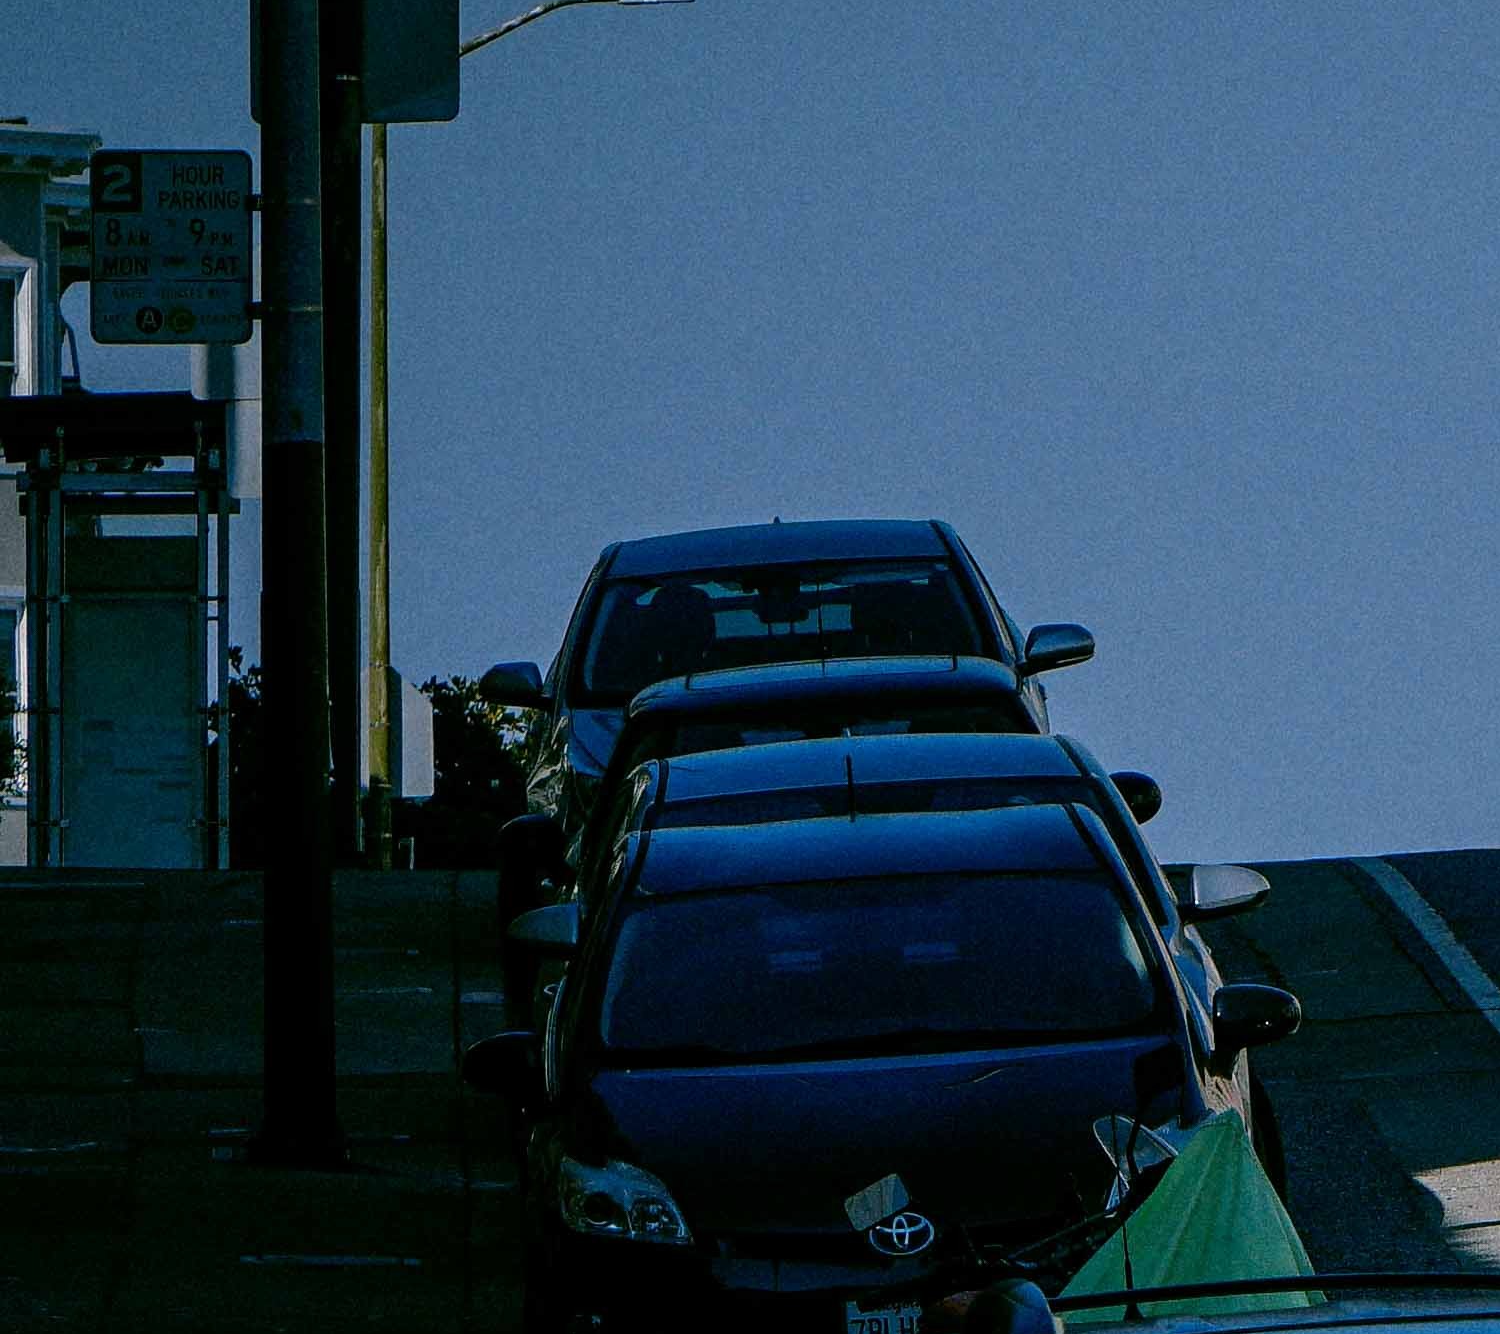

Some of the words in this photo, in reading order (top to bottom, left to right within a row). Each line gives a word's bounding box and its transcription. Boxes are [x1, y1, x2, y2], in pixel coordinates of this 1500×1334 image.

[102, 164, 133, 202] 2
[171, 163, 225, 186] HOUR
[158, 189, 241, 210] PARKING
[105, 218, 121, 247] 8
[190, 218, 206, 246] 9
[103, 255, 149, 276] MON
[200, 255, 241, 276] SAT
[141, 309, 158, 329] A
